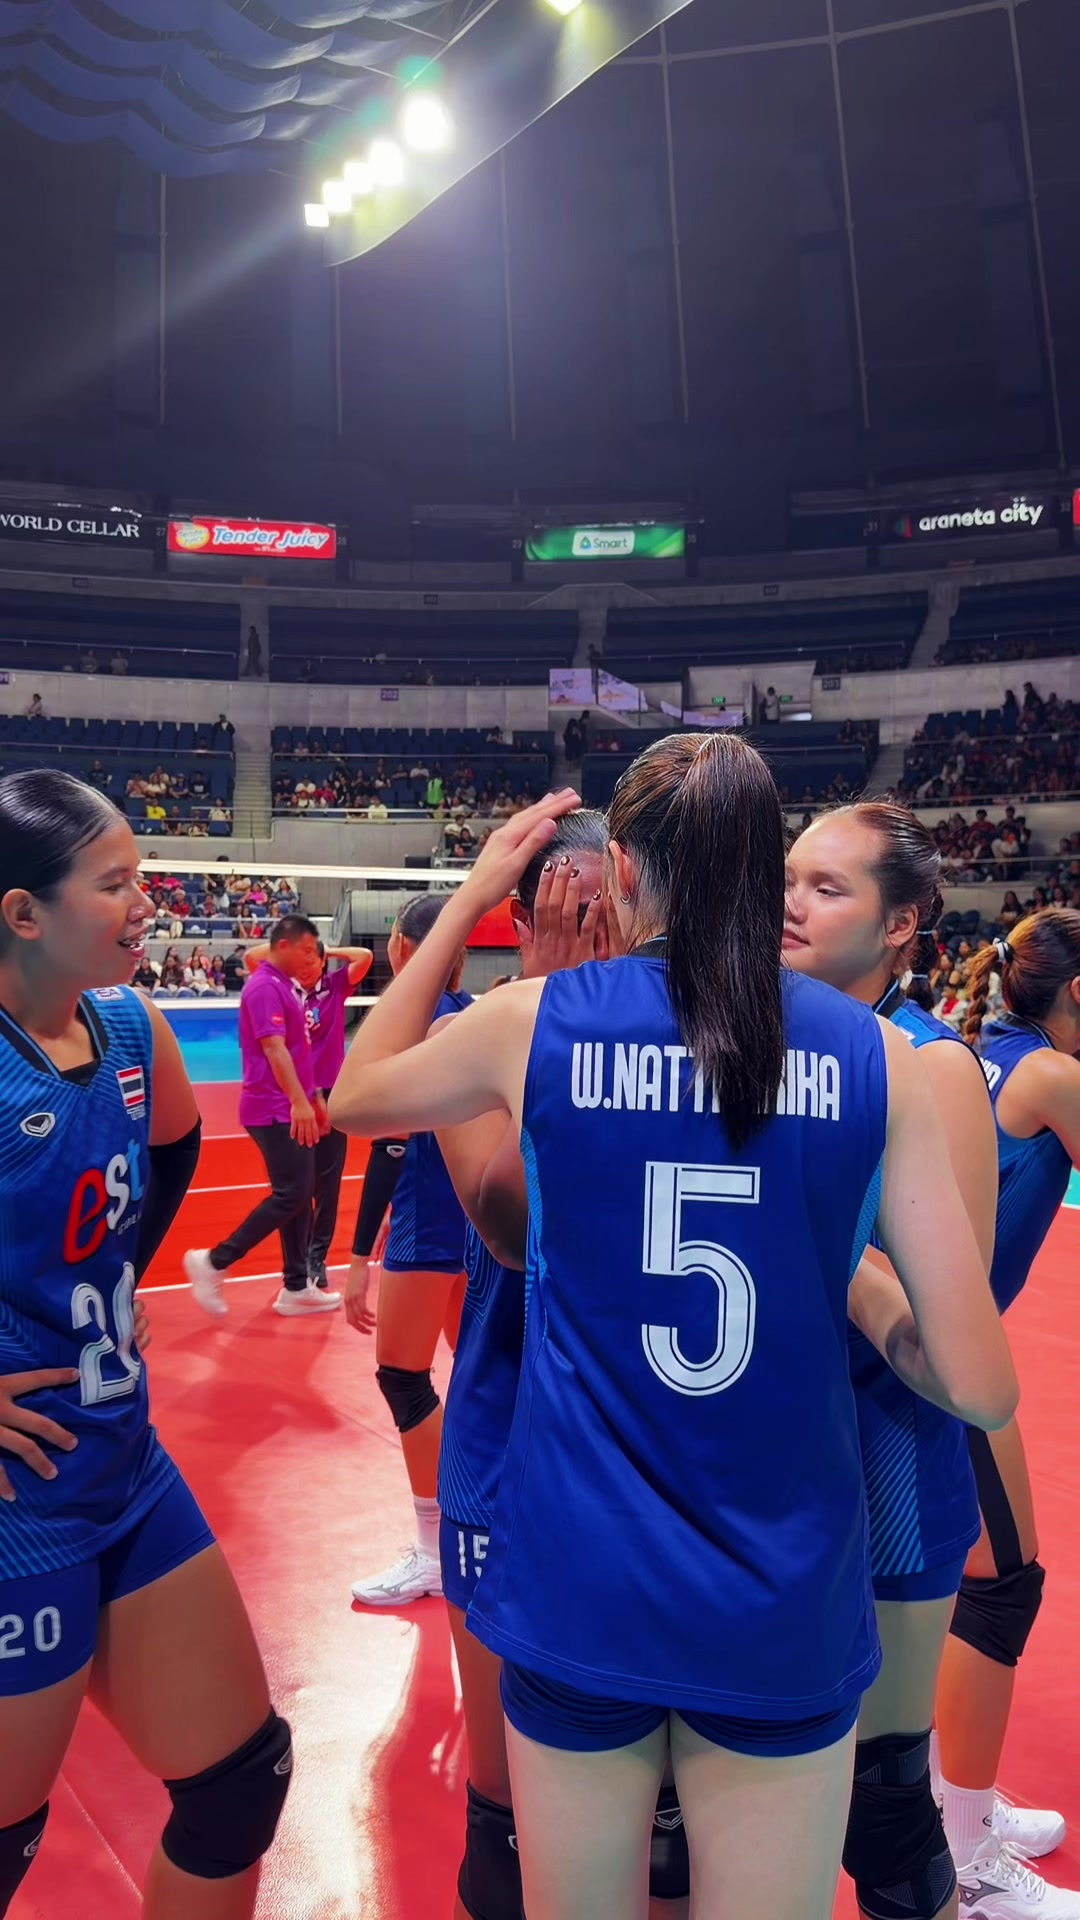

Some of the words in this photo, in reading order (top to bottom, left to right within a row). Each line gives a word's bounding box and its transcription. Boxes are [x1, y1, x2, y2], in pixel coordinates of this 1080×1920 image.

[67, 519, 140, 538] CELLAR
[919, 508, 995, 531] araneta
[1000, 499, 1044, 525] city
[213, 525, 280, 545] Tender
[275, 528, 330, 549] Juicy
[593, 537, 628, 549] Smart
[571, 1042, 840, 1121] W.NATTIKA
[64, 1138, 144, 1264] est
[642, 1161, 761, 1396] 5
[0, 1606, 61, 1659] 20
